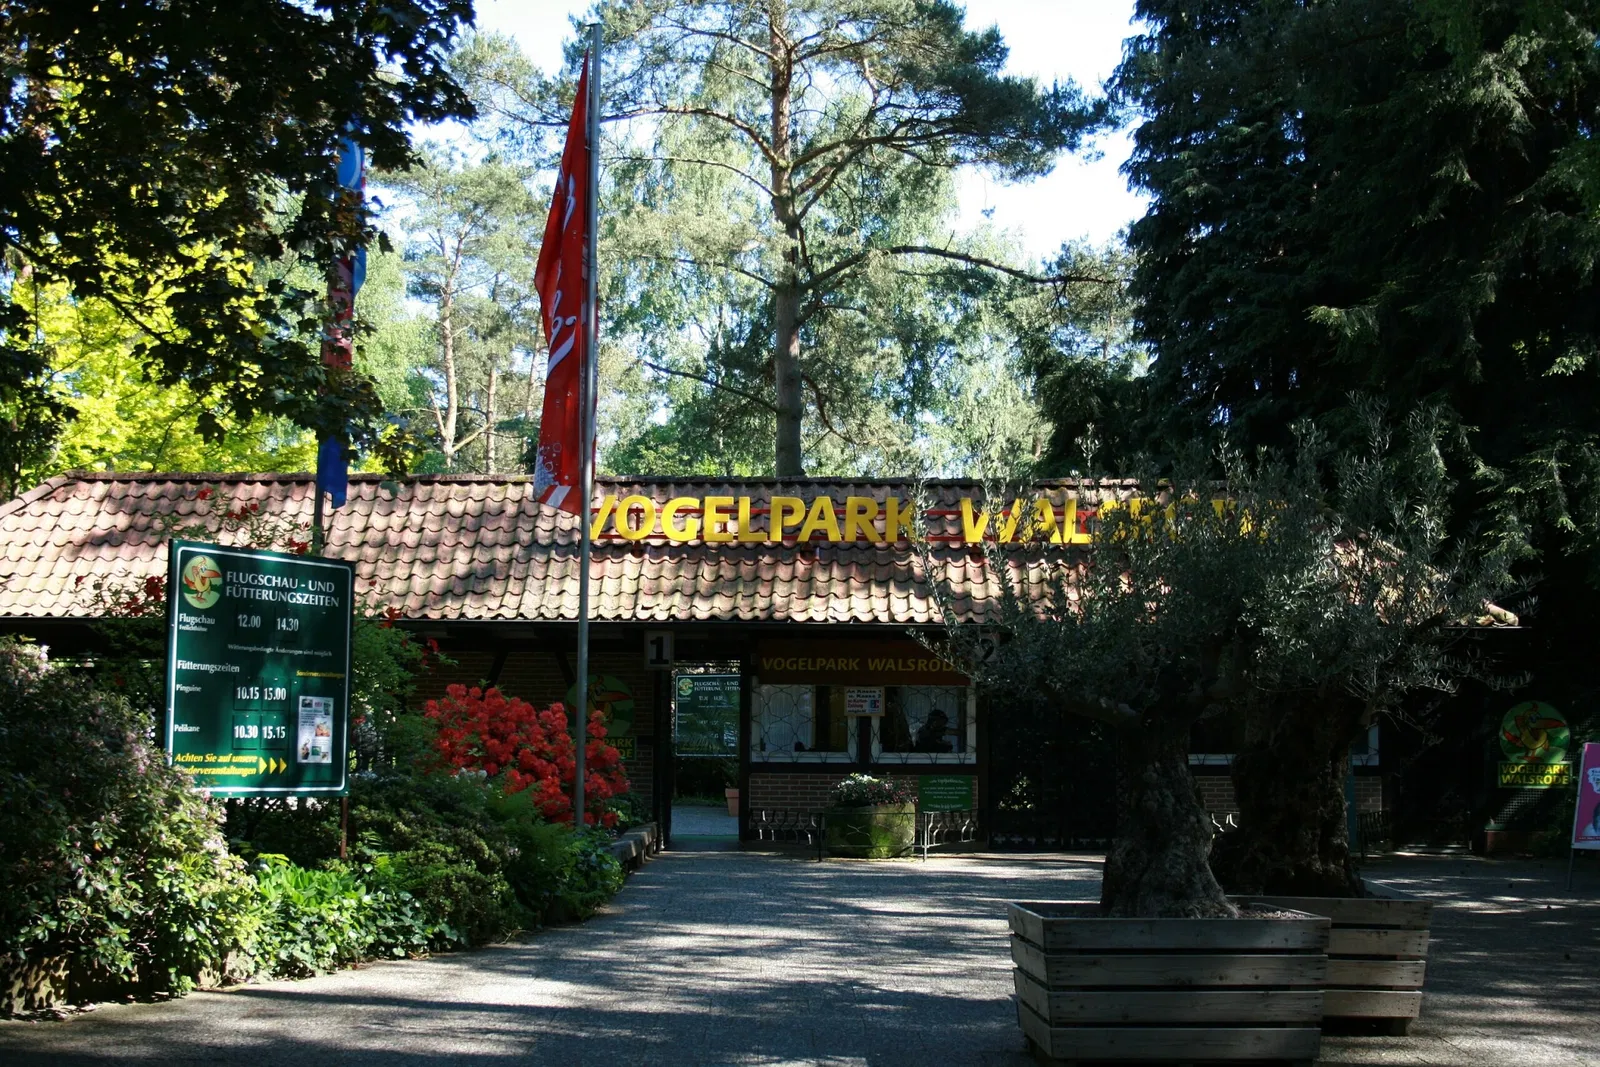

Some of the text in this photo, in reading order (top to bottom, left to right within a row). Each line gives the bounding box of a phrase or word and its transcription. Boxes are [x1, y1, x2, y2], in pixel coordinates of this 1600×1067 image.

[227, 571, 299, 589] FLUGSCHAU
[308, 580, 335, 593] UND
[226, 585, 340, 608] FÜTTERUNGSZEITEN
[179, 612, 299, 632] Flugschau 12.00 14.30
[649, 636, 670, 665] 1
[176, 660, 240, 674] Fütterungszeiten
[761, 657, 861, 673] VOGELPARK
[175, 683, 287, 701] Pinguine 10.15 15.00
[173, 723, 286, 740] Pelikane 10.30 15.15
[174, 753, 258, 765] Achten Sie auf unsere
[1501, 764, 1569, 775] VOGELPARK
[1501, 775, 1569, 785] WALSRODE
